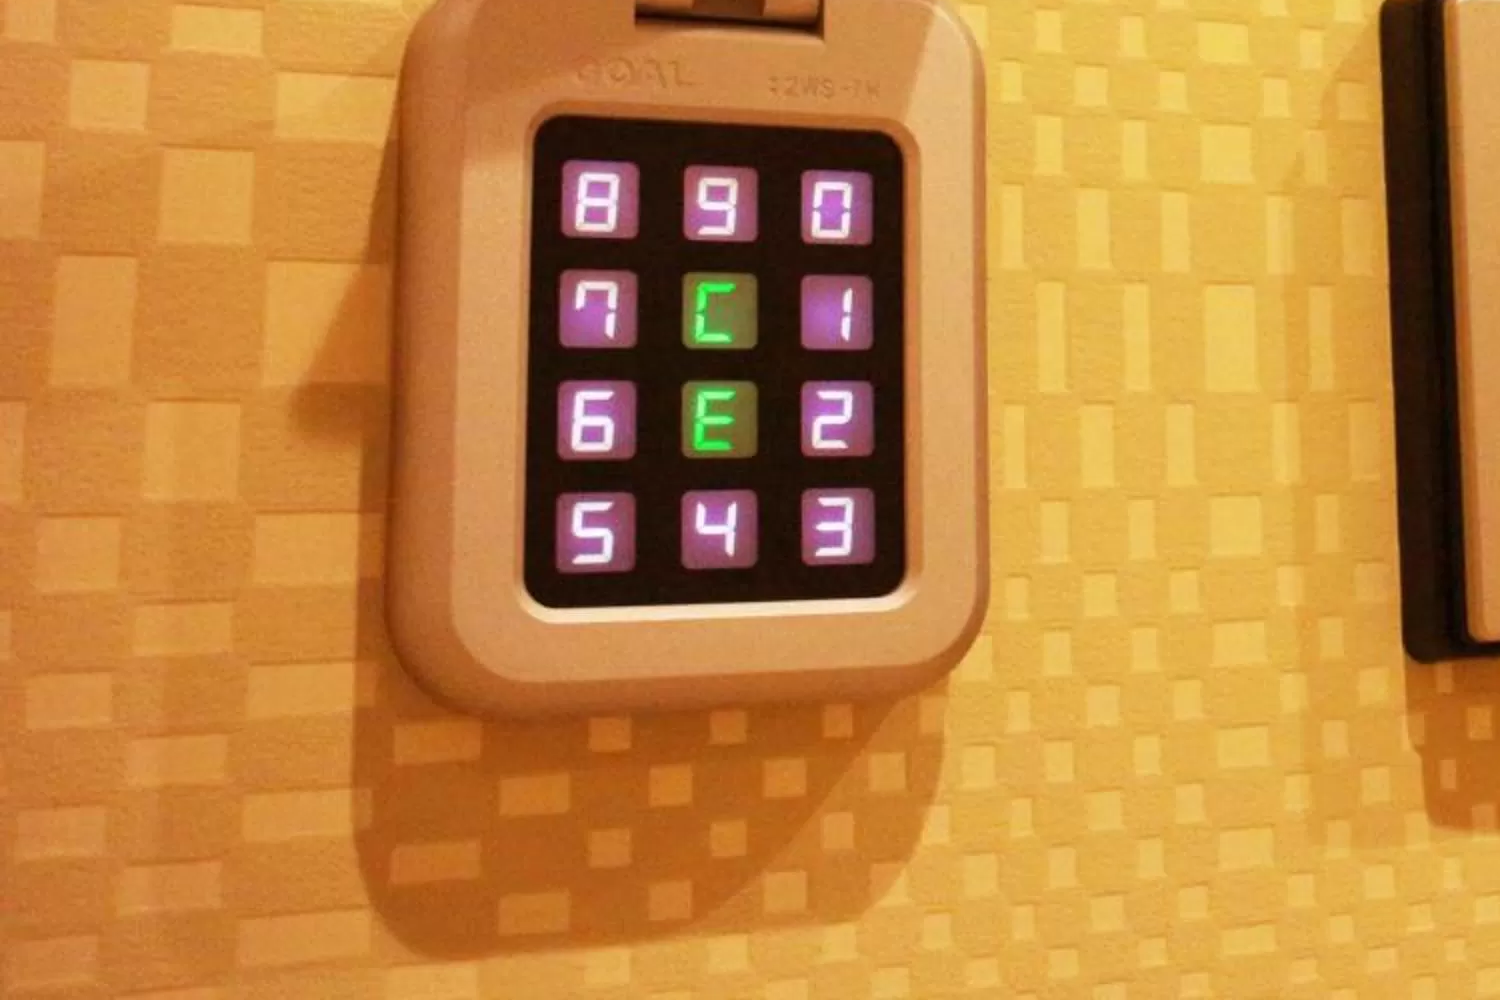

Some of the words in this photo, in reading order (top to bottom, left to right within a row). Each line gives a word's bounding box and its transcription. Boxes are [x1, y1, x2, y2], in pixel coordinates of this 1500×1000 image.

[573, 171, 621, 233] 8
[697, 176, 739, 236] 9
[810, 180, 854, 239] 0
[575, 279, 618, 339] 7
[694, 281, 737, 344] C
[570, 390, 615, 452] 6
[692, 390, 736, 451] E
[811, 390, 854, 449] 2
[570, 501, 614, 566] 5
[695, 500, 738, 558] 4
[814, 496, 854, 557] 3
